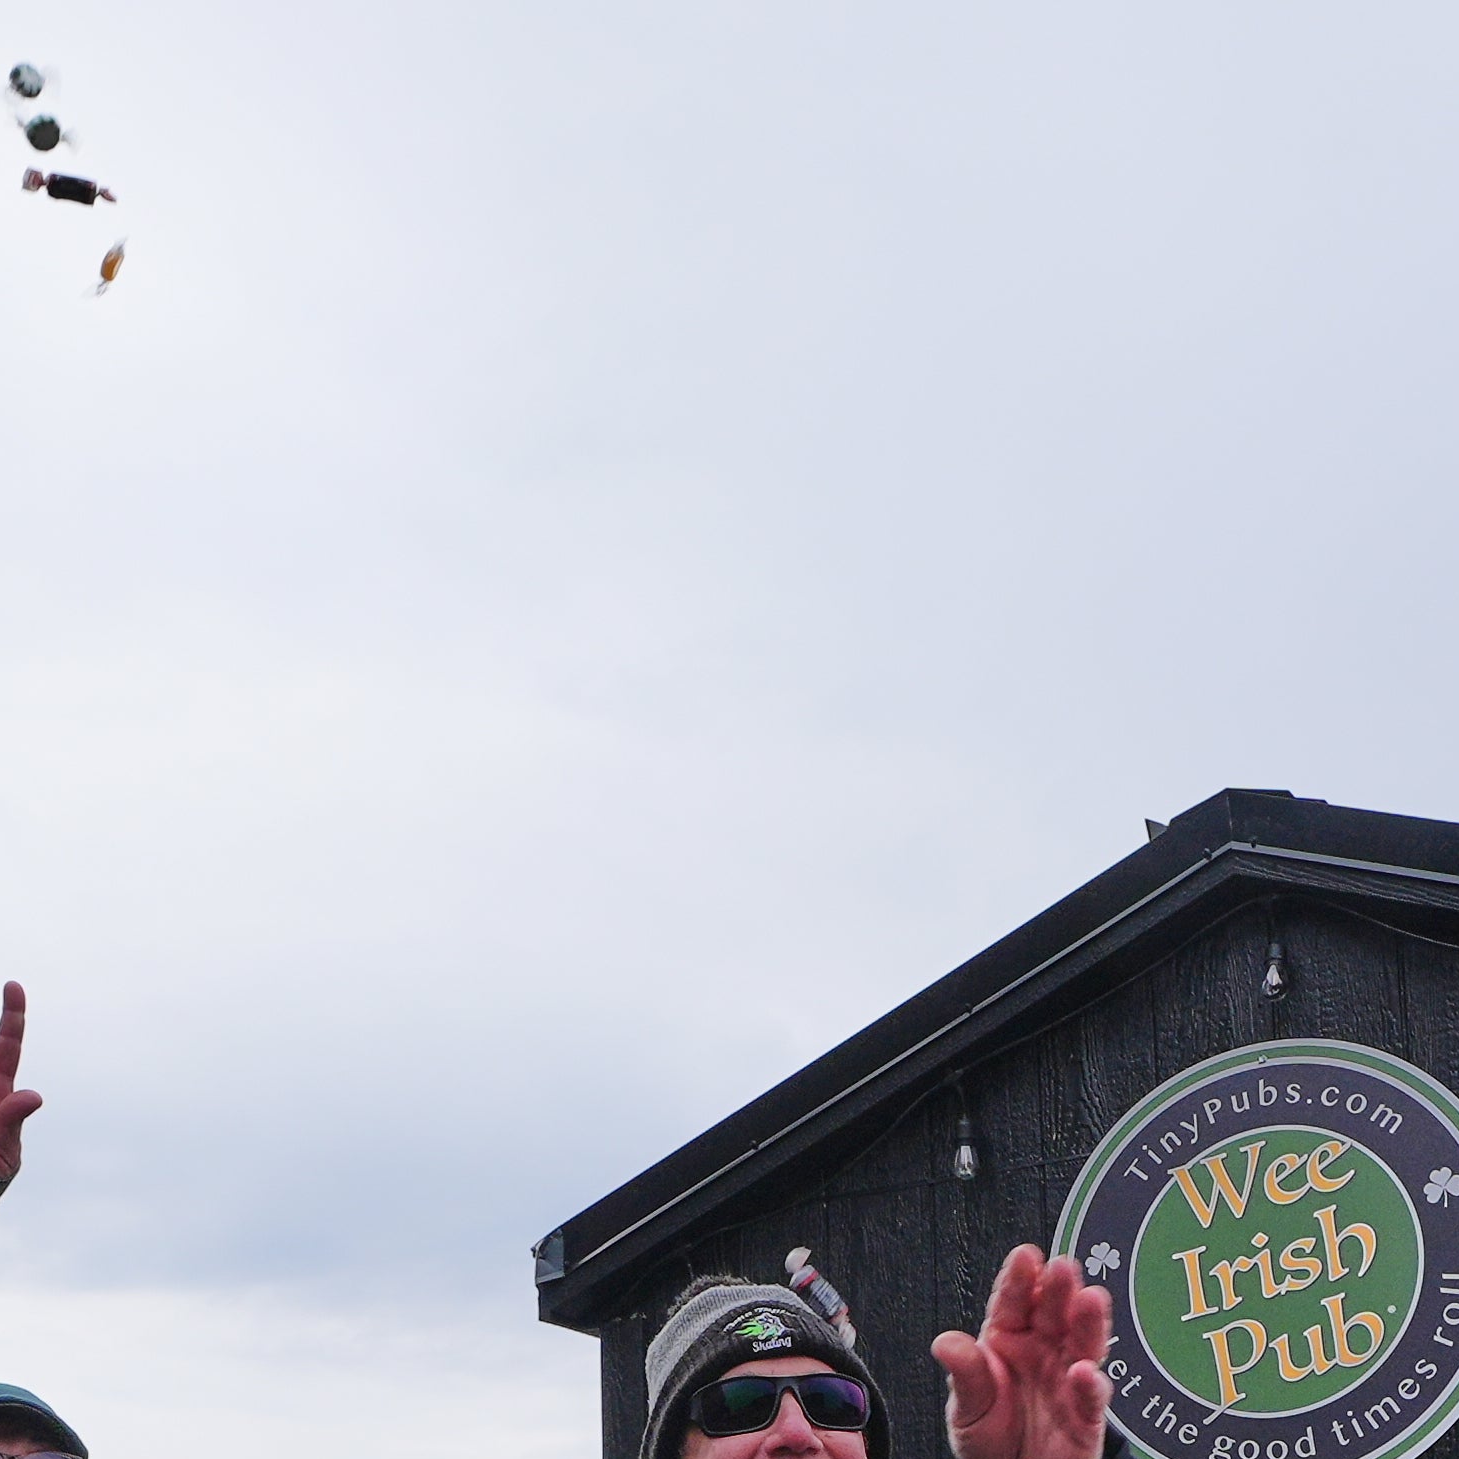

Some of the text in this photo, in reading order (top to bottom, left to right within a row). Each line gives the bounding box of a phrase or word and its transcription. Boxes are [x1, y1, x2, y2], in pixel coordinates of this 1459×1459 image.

[1124, 1079, 1404, 1182] TinyPubs.com
[1167, 1140, 1355, 1228] Wee
[1172, 1204, 1377, 1321] Irish
[752, 1336, 792, 1353] Skating
[1202, 1293, 1385, 1425] Pub
[1141, 1394, 1199, 1445] the
[1331, 1357, 1438, 1447] times
